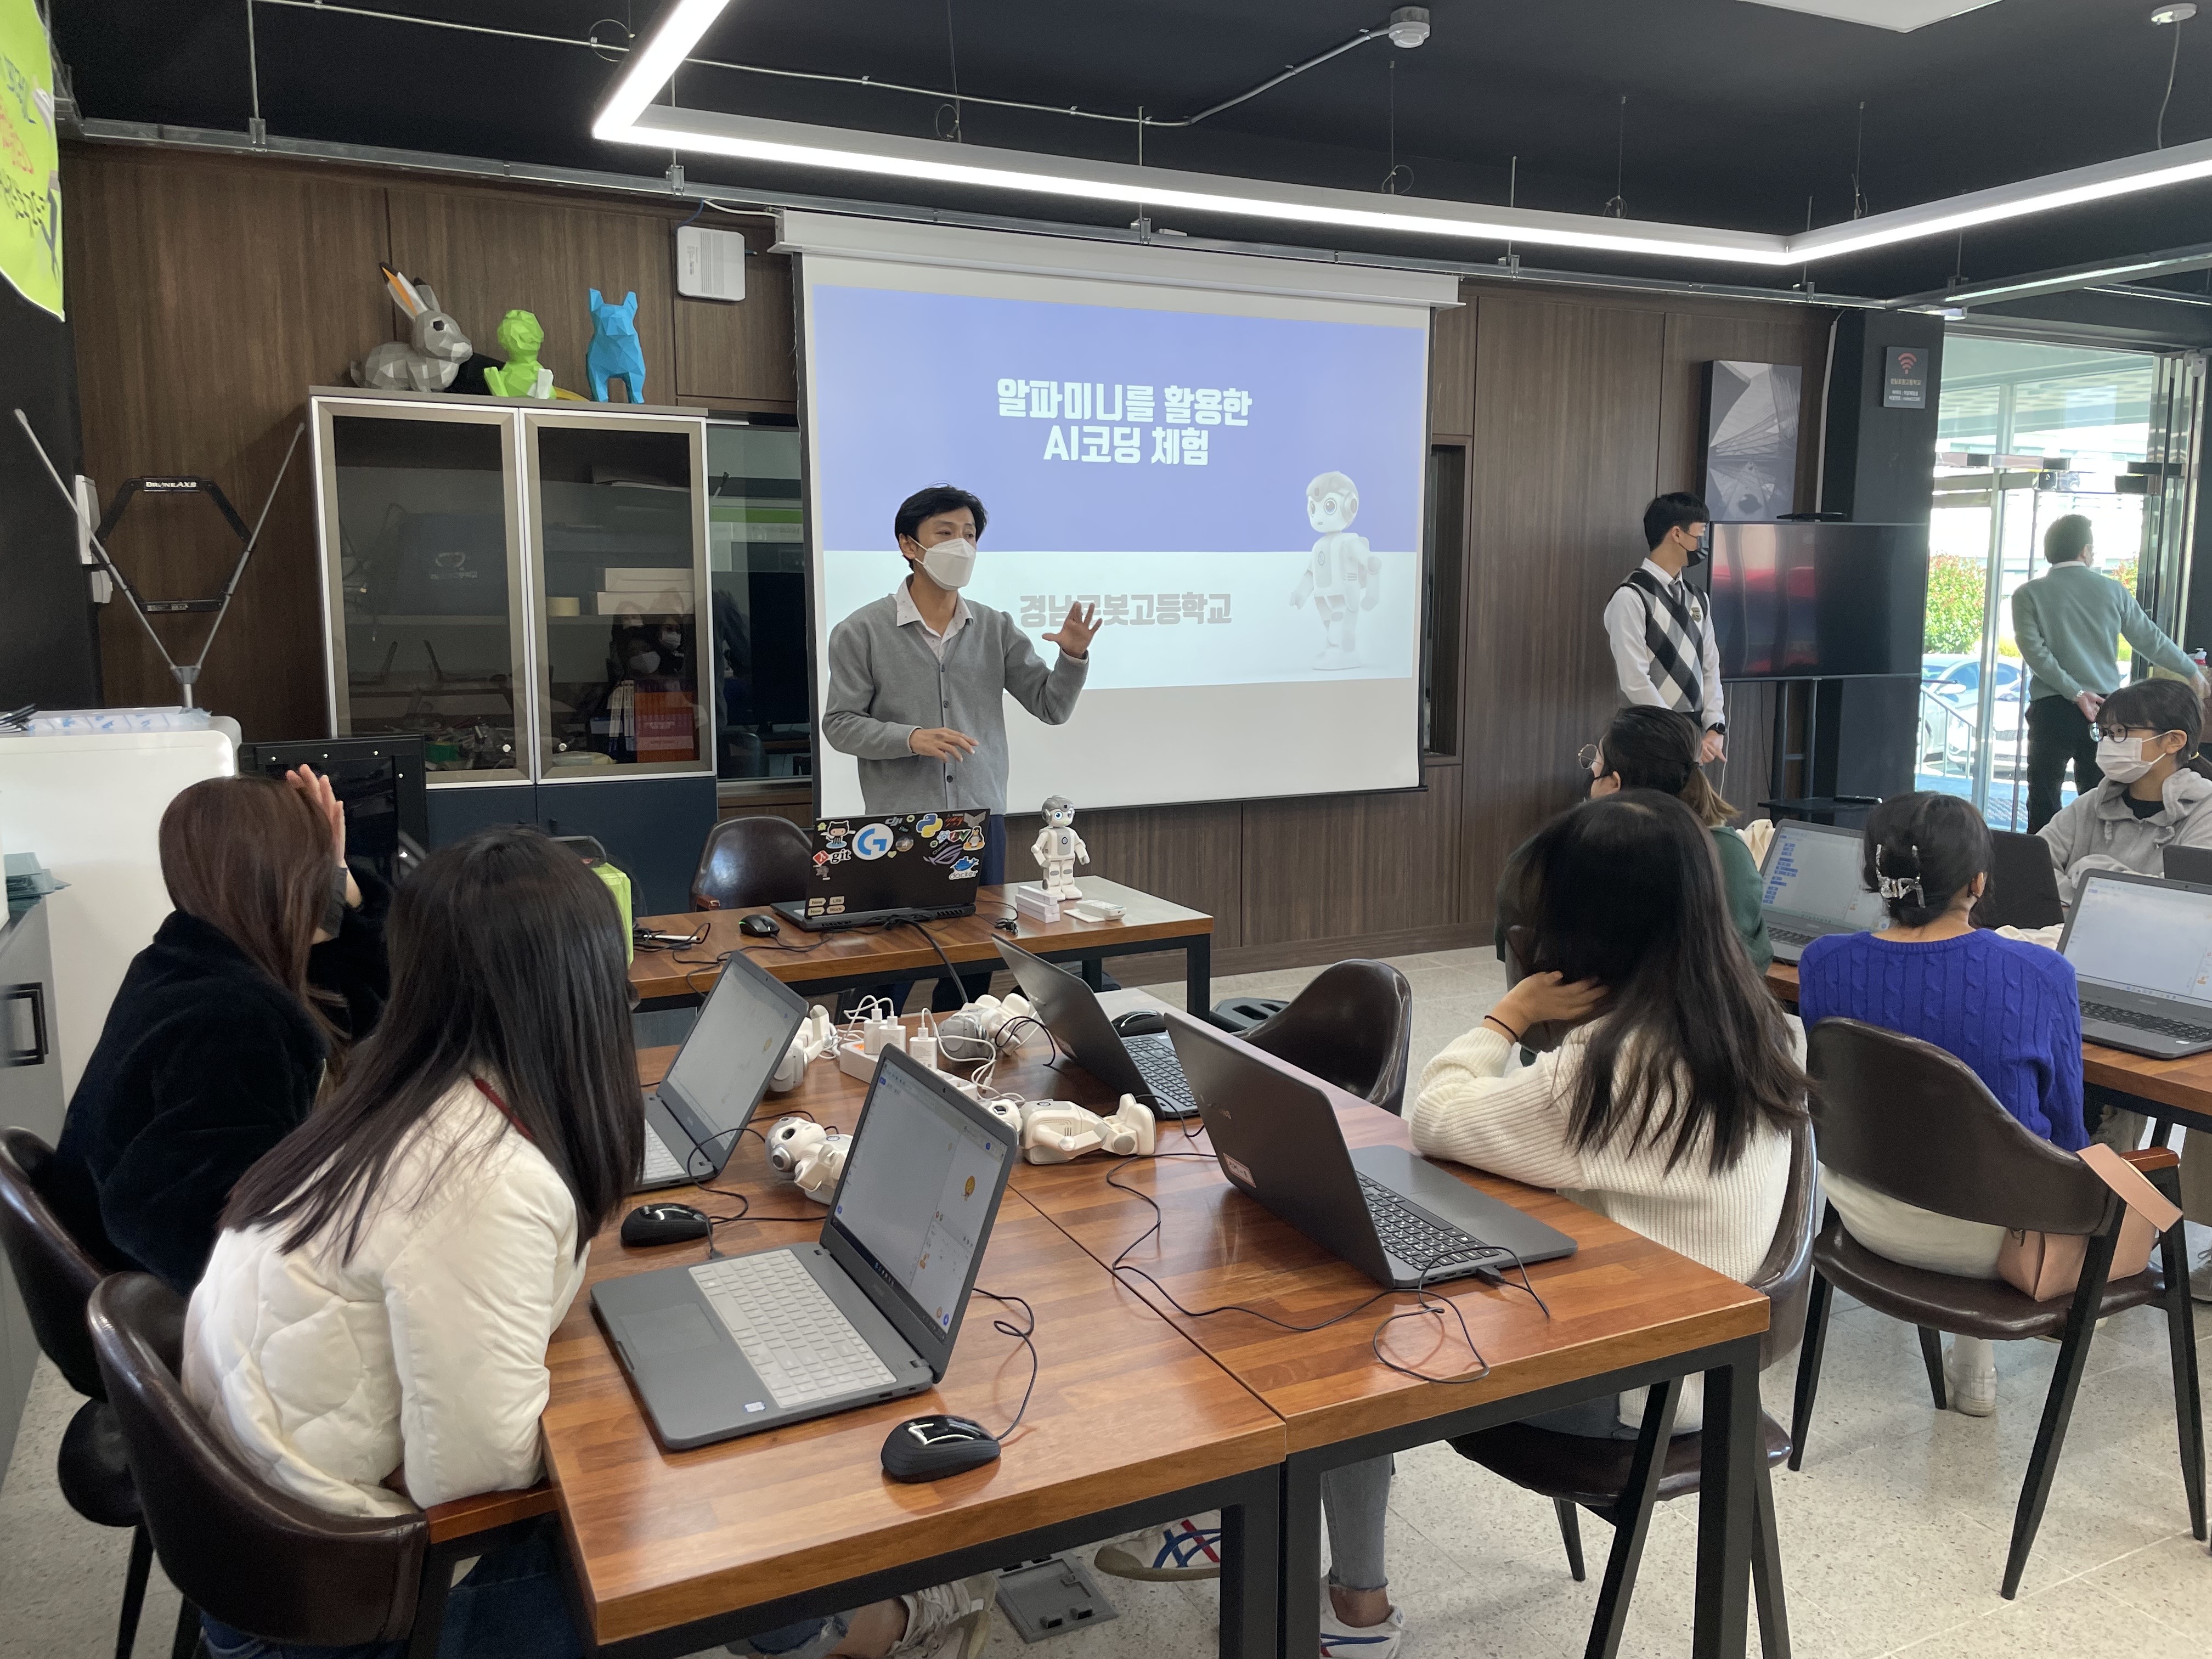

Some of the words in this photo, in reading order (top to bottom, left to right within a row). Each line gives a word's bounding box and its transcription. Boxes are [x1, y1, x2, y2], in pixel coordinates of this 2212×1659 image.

[997, 378, 1155, 422] 알파미니를
[1164, 385, 1252, 426] 활용한
[1043, 425, 1141, 464] AI코딩
[1150, 426, 1209, 465] 체험
[831, 849, 851, 862] git
